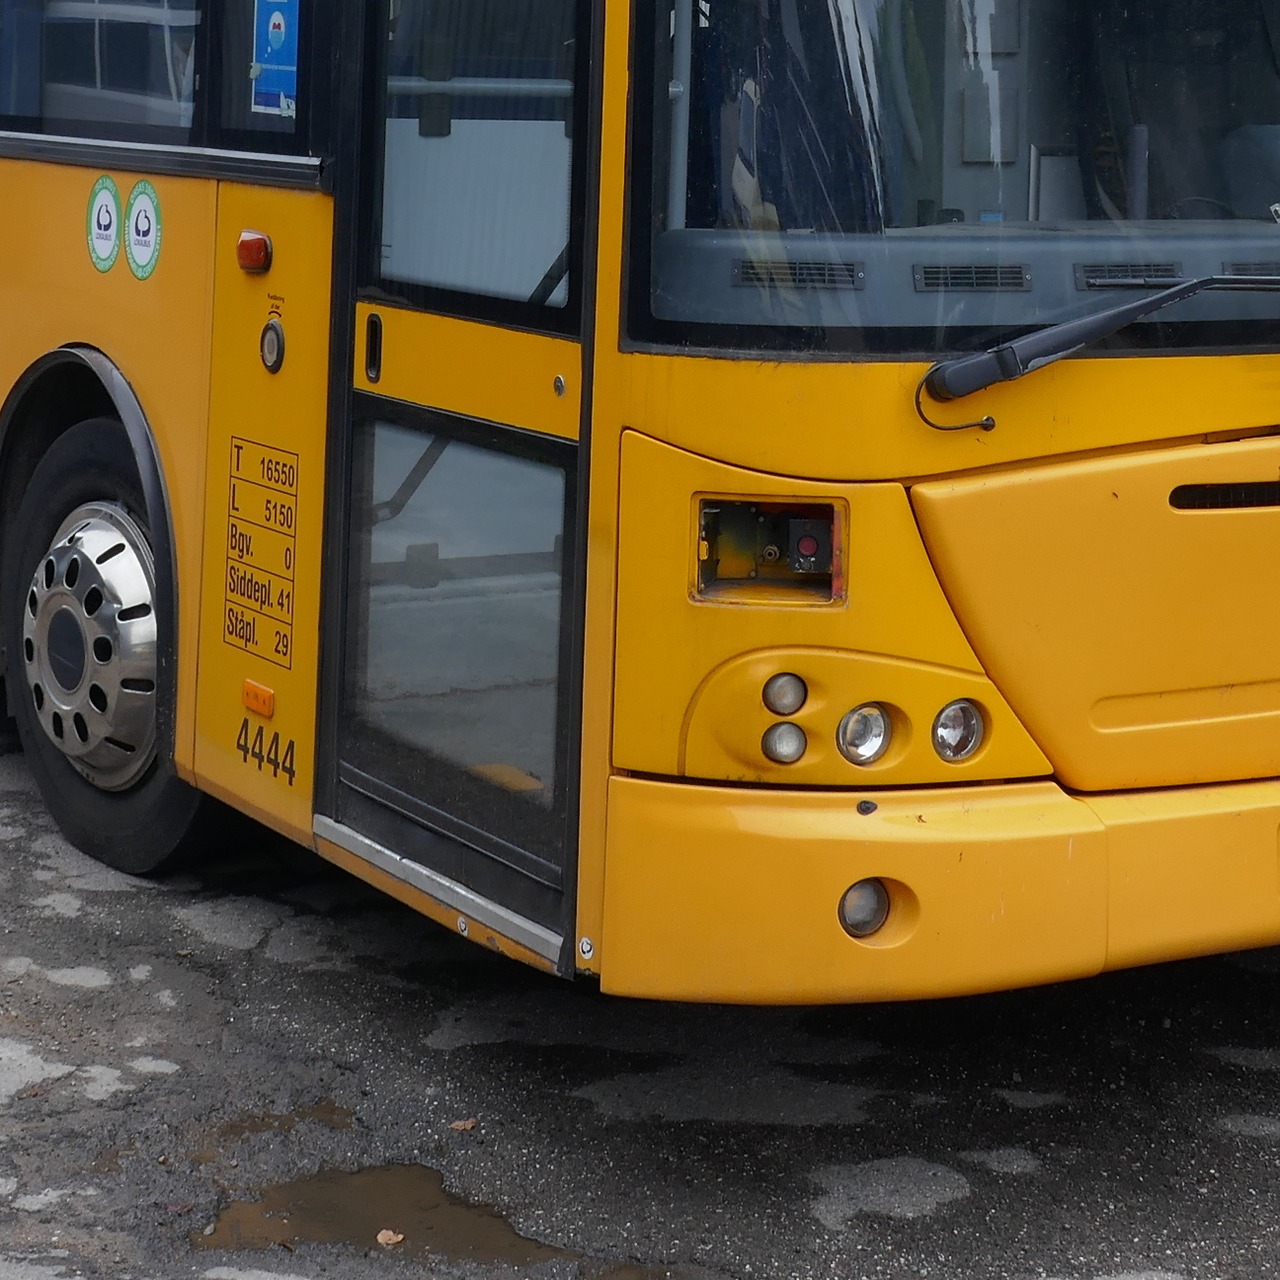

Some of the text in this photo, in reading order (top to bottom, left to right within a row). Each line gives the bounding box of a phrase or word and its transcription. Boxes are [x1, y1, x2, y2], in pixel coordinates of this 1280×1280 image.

[233, 444, 295, 488] T 16550
[231, 483, 293, 529] L 5150
[230, 523, 292, 570] Bgv. 0
[228, 565, 292, 615] Siddepl. 41
[226, 607, 289, 657] Ståpl. 29
[236, 717, 296, 788] 4444
